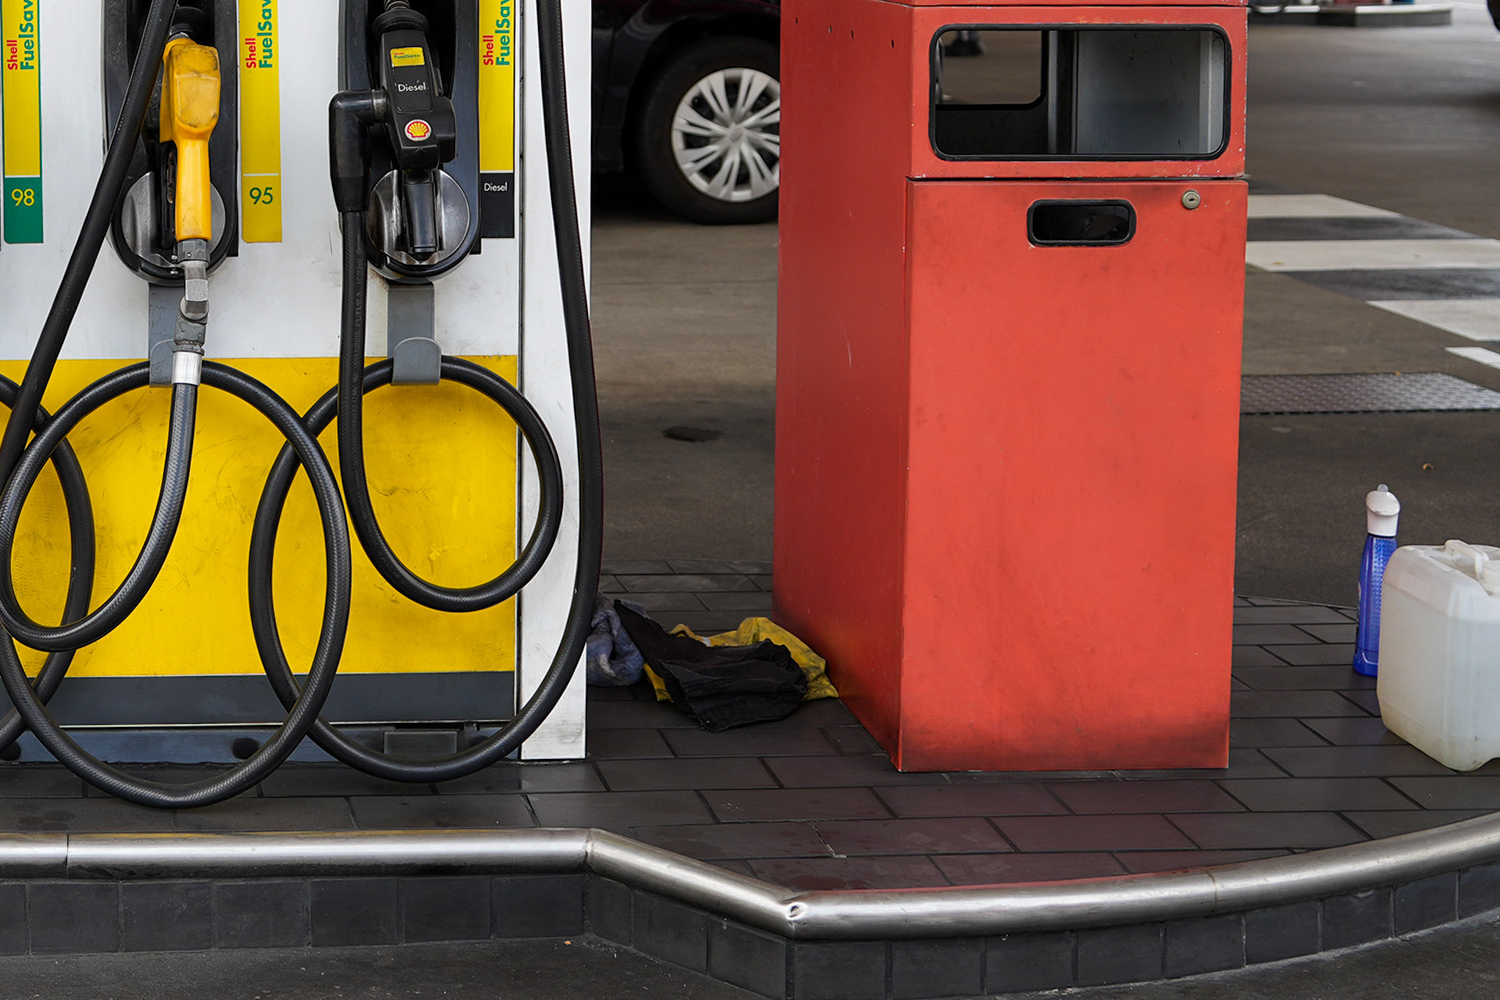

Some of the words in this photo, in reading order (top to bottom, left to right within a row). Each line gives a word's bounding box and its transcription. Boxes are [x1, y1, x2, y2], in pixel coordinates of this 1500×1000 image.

[7, 39, 18, 70] Shell
[246, 37, 257, 68] Shell
[483, 34, 494, 66] Shell
[398, 82, 427, 93] Diesel
[250, 187, 274, 205] 95
[484, 182, 508, 192] Diesel
[11, 188, 35, 207] 98
